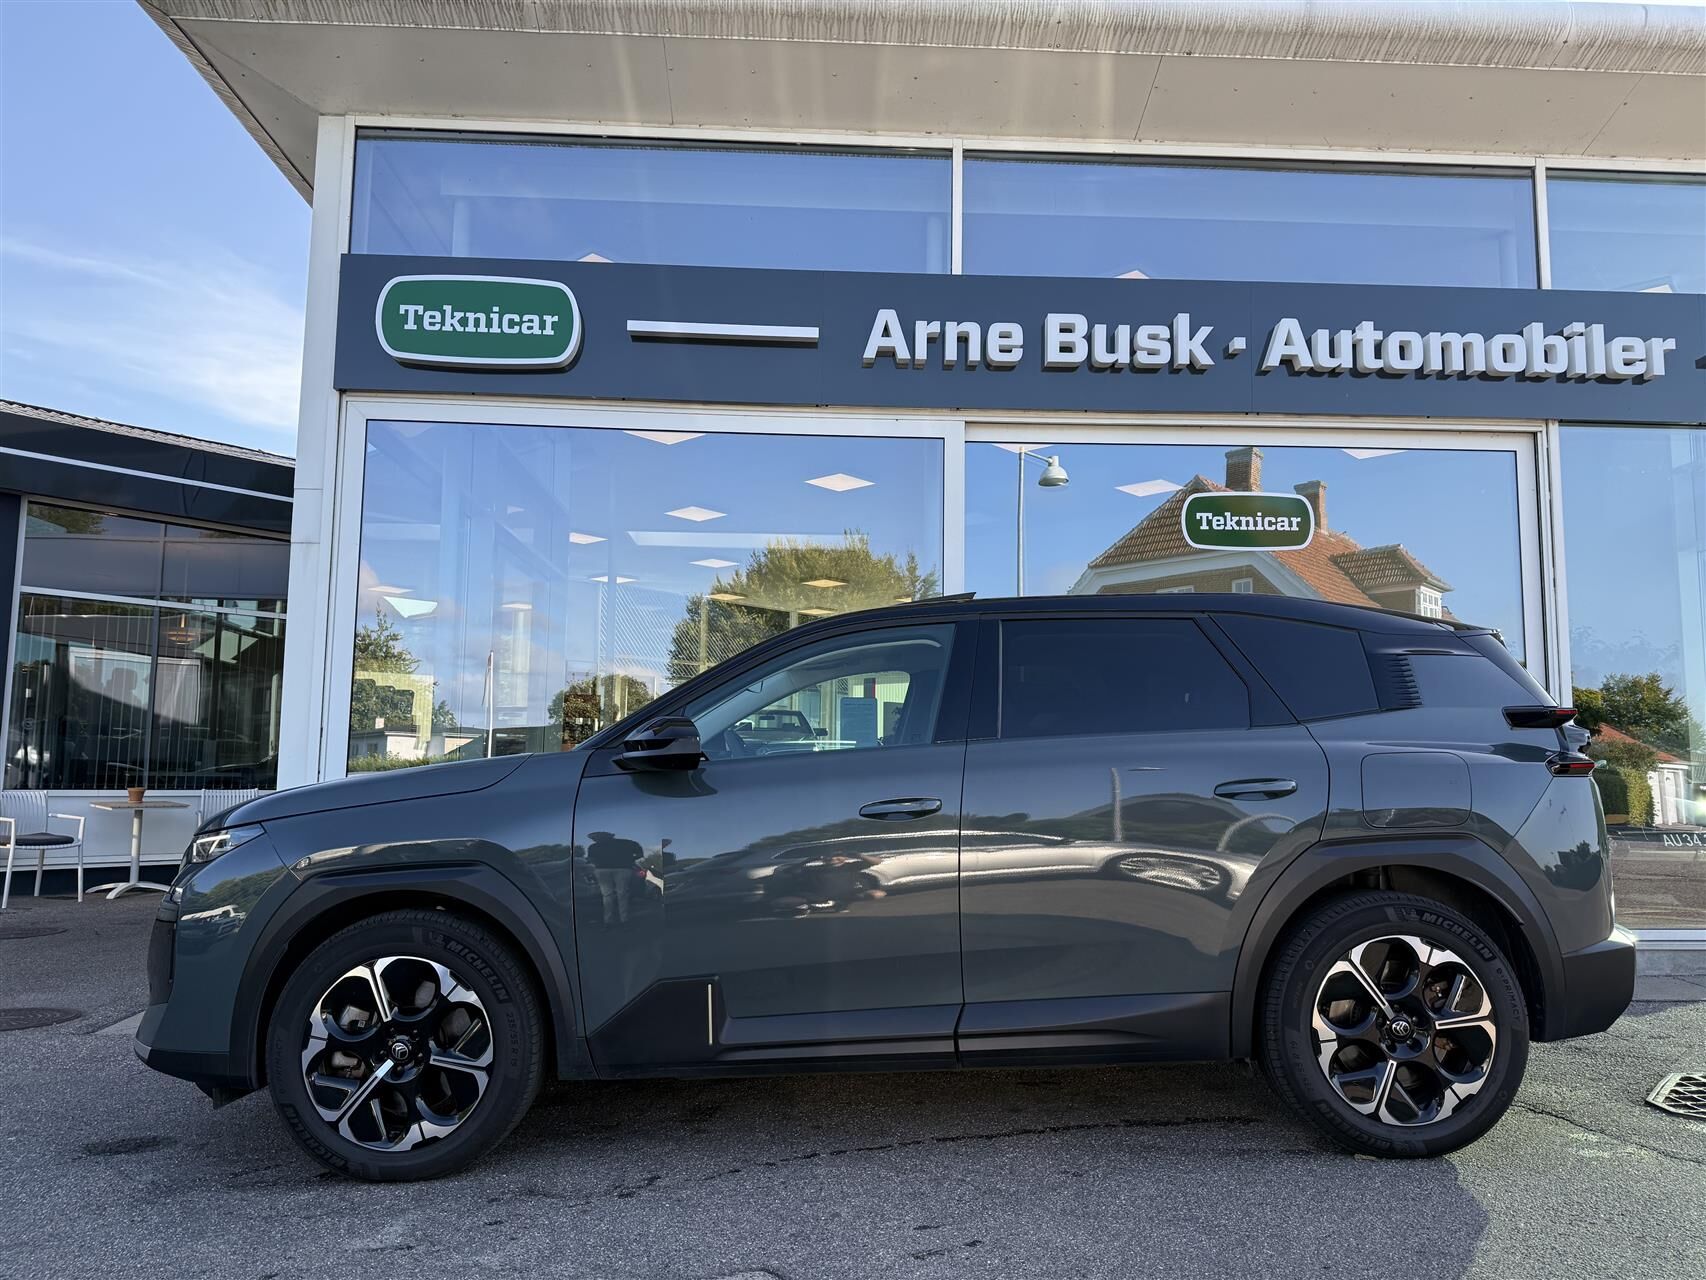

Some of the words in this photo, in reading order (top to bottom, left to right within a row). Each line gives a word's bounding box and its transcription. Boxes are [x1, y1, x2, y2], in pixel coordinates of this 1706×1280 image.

[399, 304, 559, 336] Teknicar
[862, 308, 1024, 368] Arne
[1042, 312, 1216, 370] Busk
[1260, 317, 1677, 381] Automobiler
[1196, 511, 1301, 532] Teknicar
[1663, 833, 1683, 847] AU
[1421, 912, 1494, 962] MICHELIN
[446, 939, 510, 1003] MICHELIN
